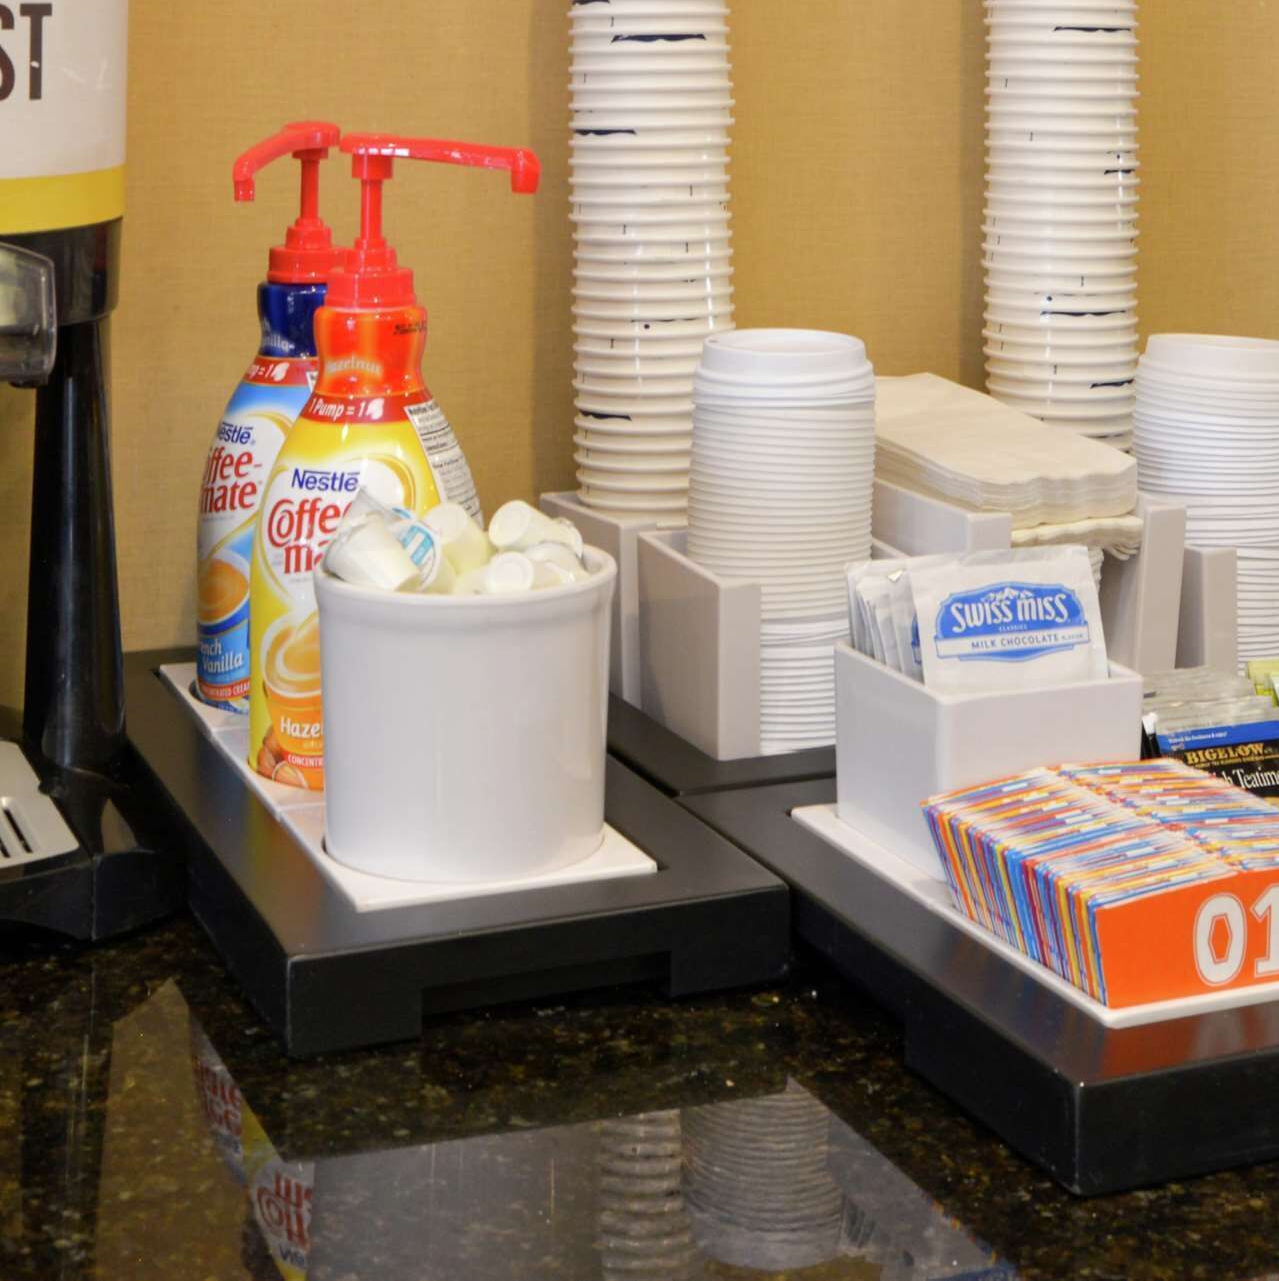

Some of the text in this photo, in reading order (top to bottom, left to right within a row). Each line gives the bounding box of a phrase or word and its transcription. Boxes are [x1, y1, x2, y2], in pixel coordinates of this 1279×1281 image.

[267, 497, 353, 548] Coffe
[971, 638, 997, 650] MILK
[1000, 633, 1059, 648] CHOCOLATE
[1185, 742, 1266, 766] BIGELOW
